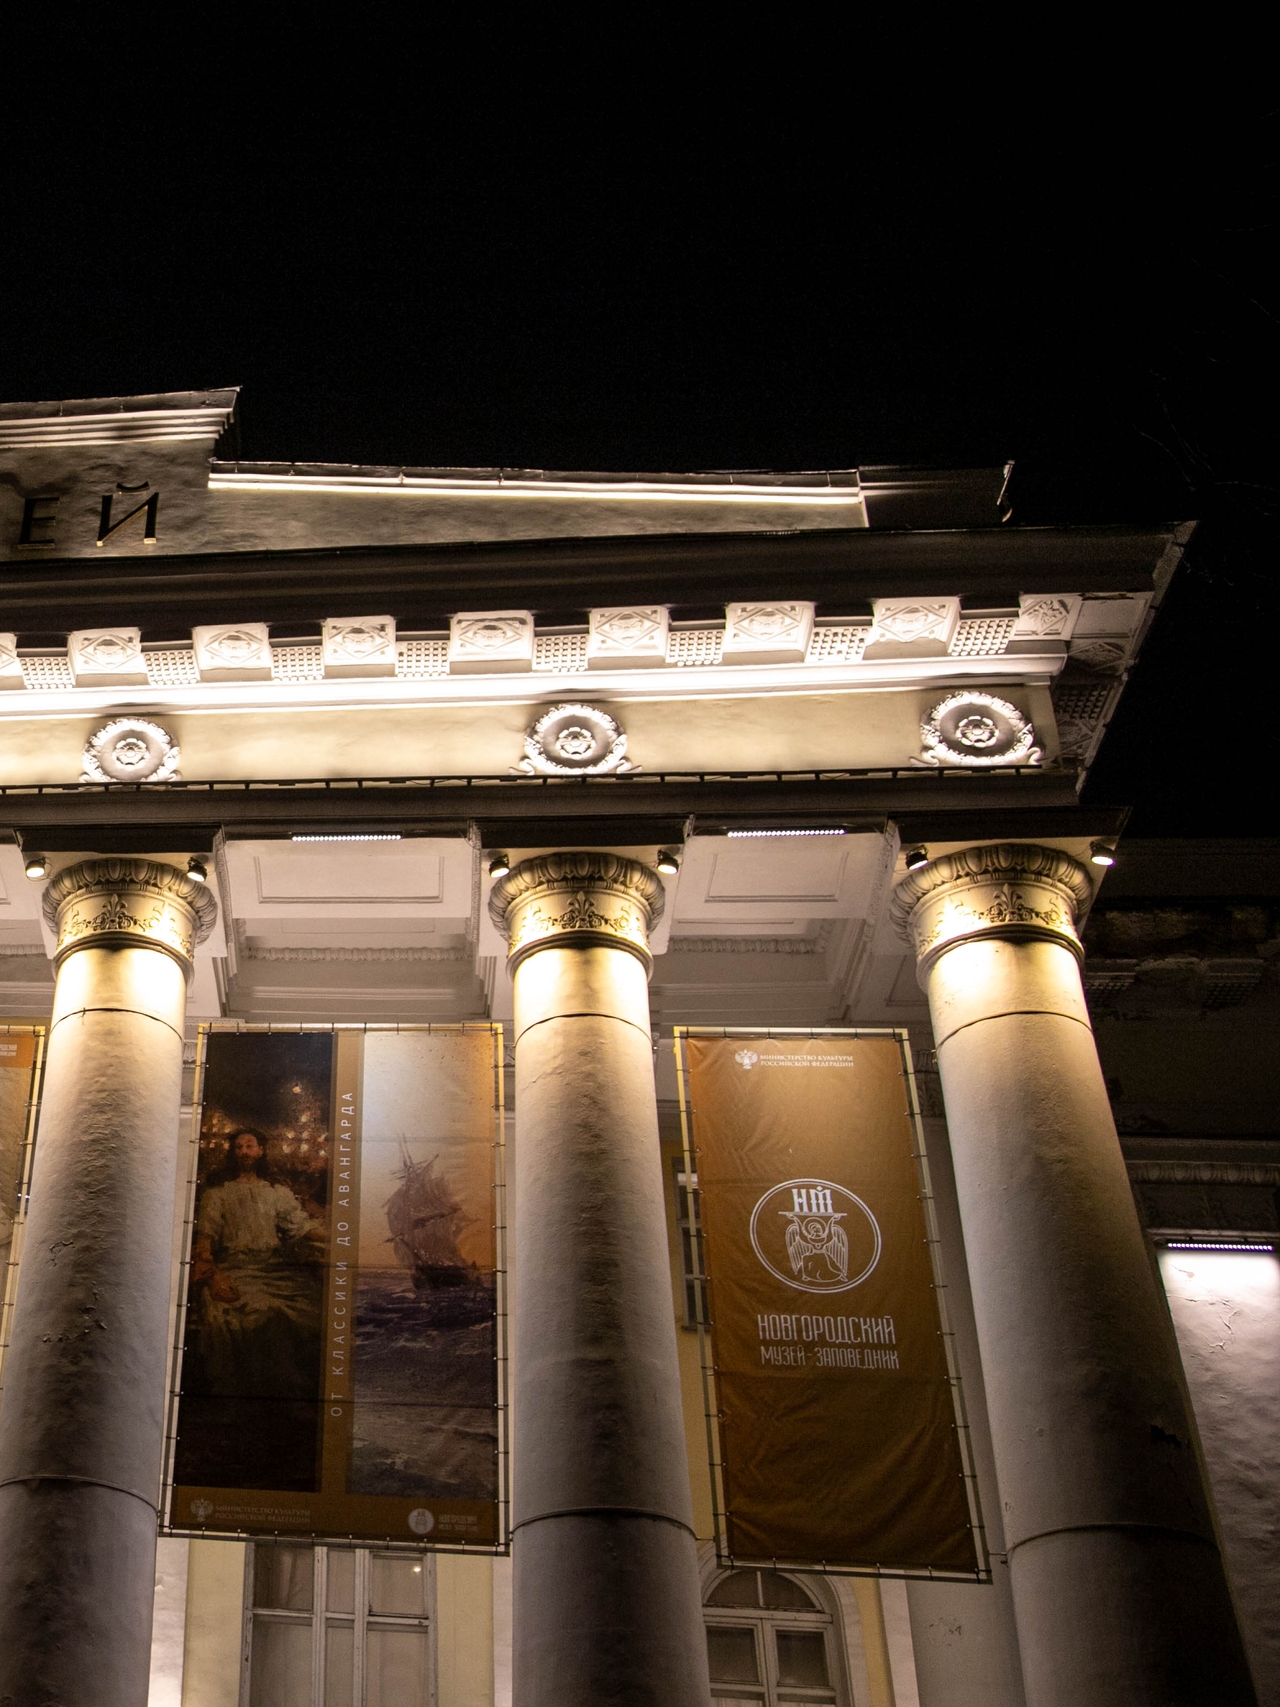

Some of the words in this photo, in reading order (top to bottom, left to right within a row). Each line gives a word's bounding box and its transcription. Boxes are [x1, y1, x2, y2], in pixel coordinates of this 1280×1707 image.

[338, 1092, 354, 1206] АВАНГАРДА
[337, 1222, 350, 1246] ДО
[332, 1262, 347, 1375] КЛАССИКИ
[757, 1314, 896, 1344] НОВГОРОДСКИЙ
[331, 1392, 342, 1417] ОТ
